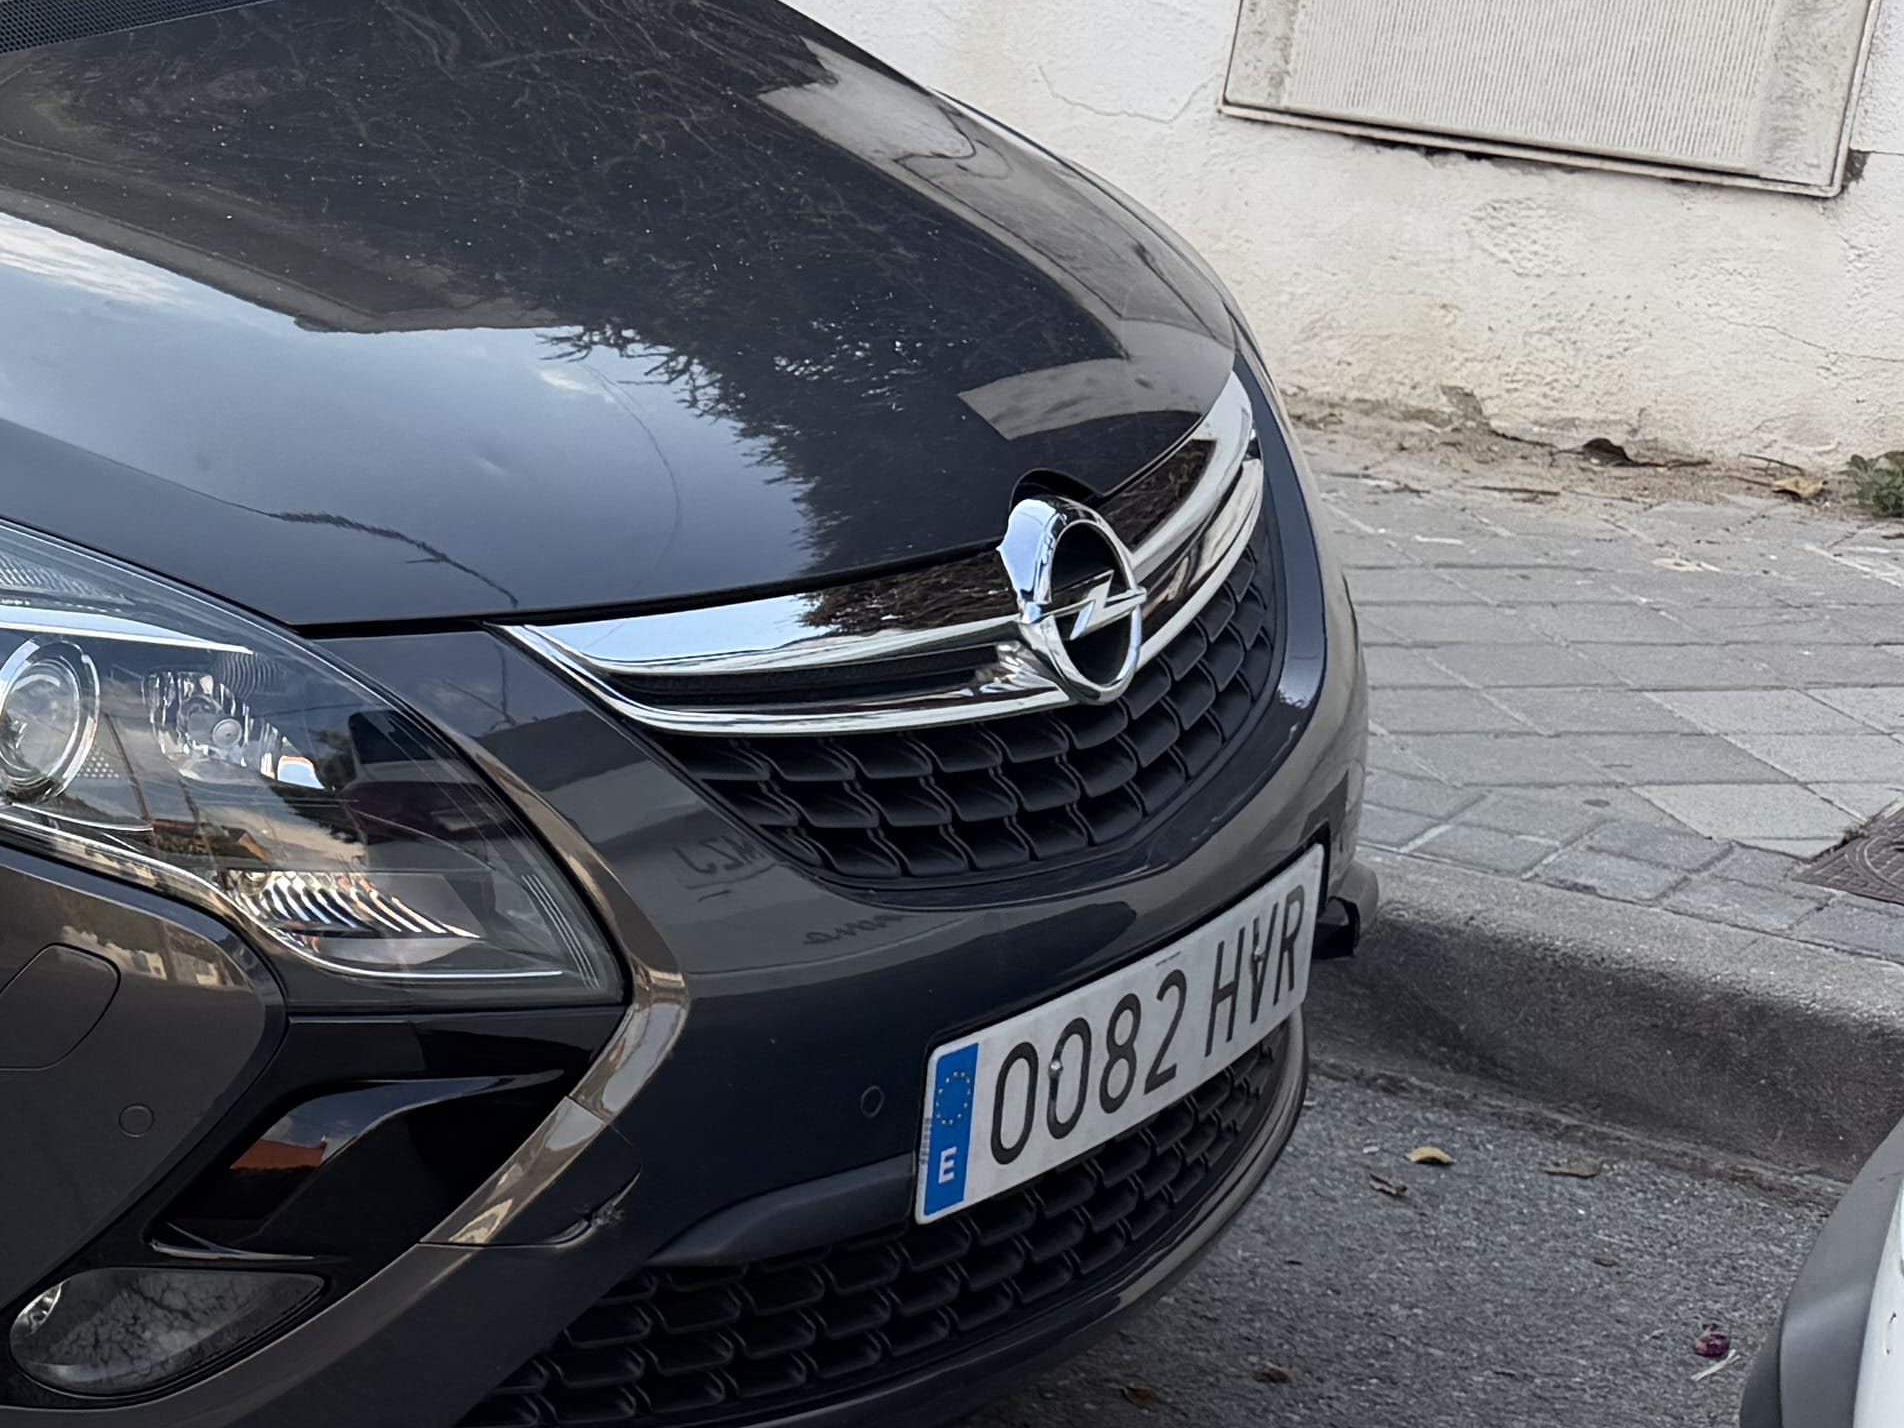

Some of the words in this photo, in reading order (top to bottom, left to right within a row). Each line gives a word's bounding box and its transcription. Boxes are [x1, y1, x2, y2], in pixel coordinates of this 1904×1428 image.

[990, 968, 1188, 1166] 0082
[1204, 884, 1306, 1058] HVR
[937, 1146, 957, 1184] E
